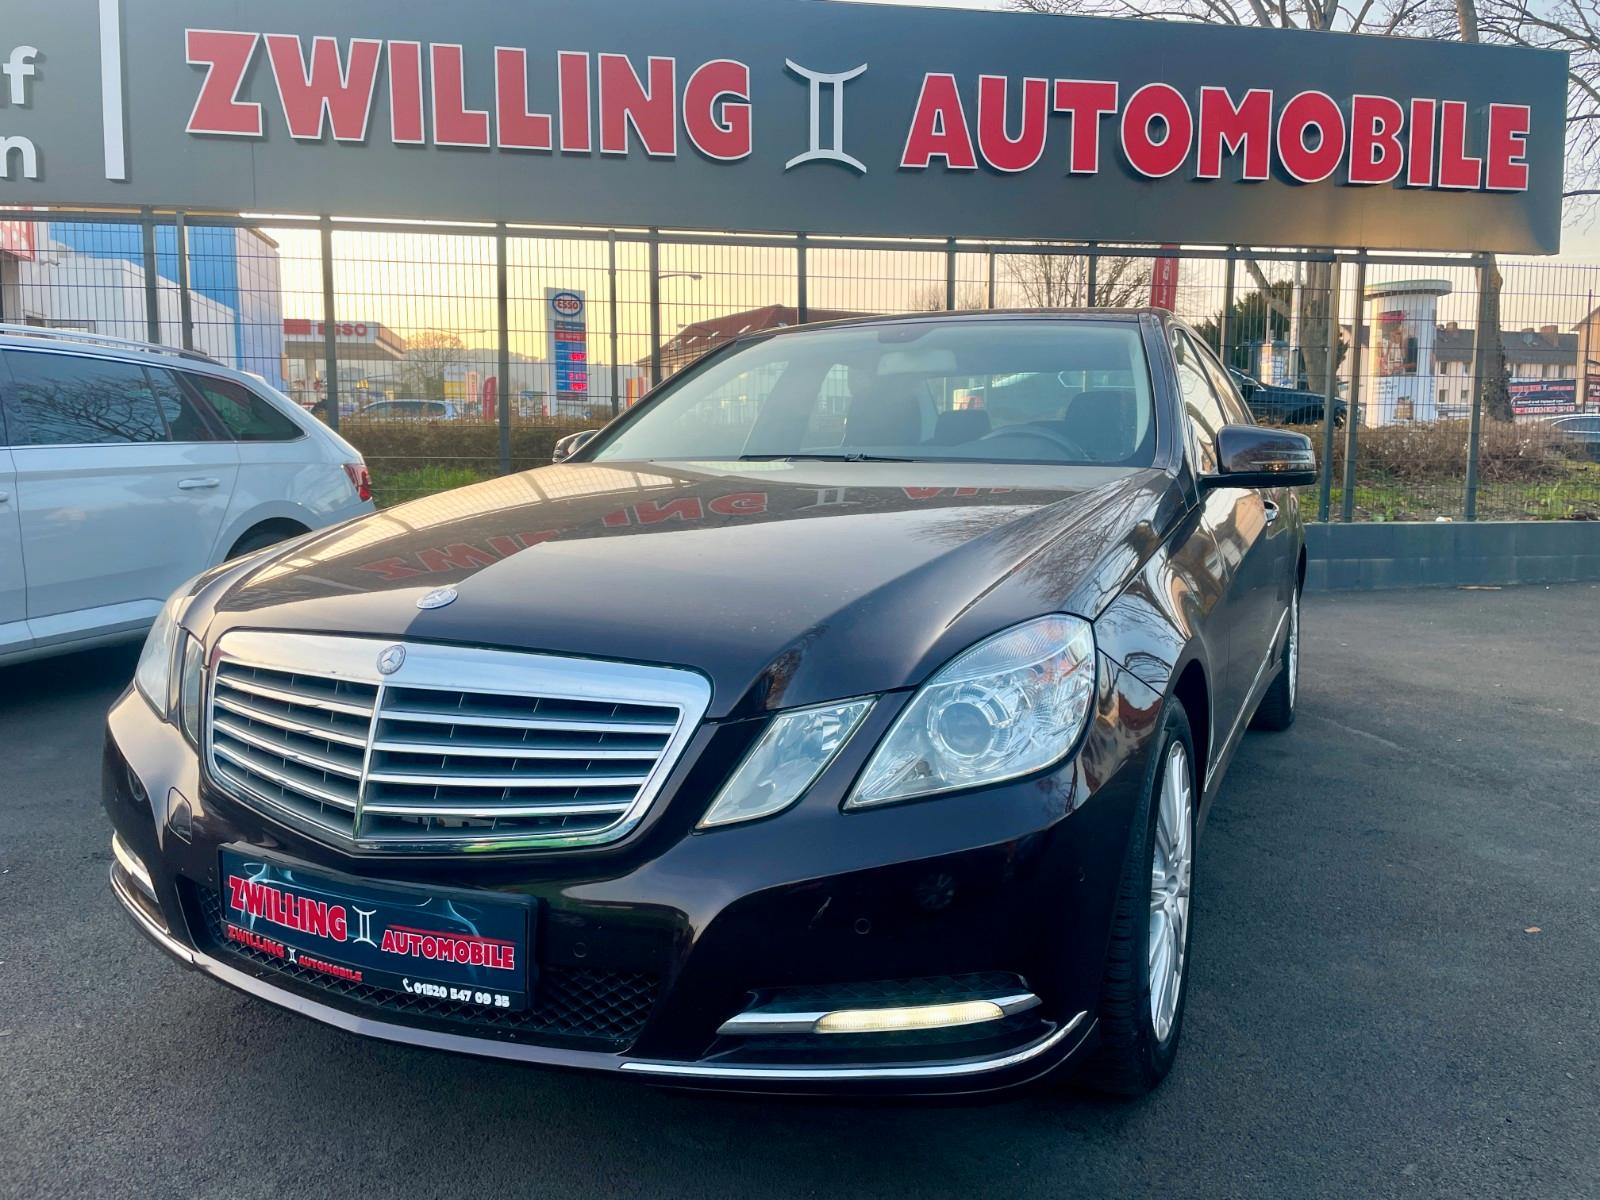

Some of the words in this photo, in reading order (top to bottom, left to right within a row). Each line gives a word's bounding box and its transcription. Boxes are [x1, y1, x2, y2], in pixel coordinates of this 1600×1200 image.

[184, 28, 753, 161] ZWILLING
[899, 71, 1531, 192] AUTOMOBILE
[227, 924, 285, 958] ZWILLING
[298, 954, 363, 983] AUTOMOBILE
[229, 874, 348, 942] ZWILLING
[381, 929, 515, 970] AUTOMOBILE
[413, 982, 448, 998] 01520
[449, 987, 472, 1002] 547
